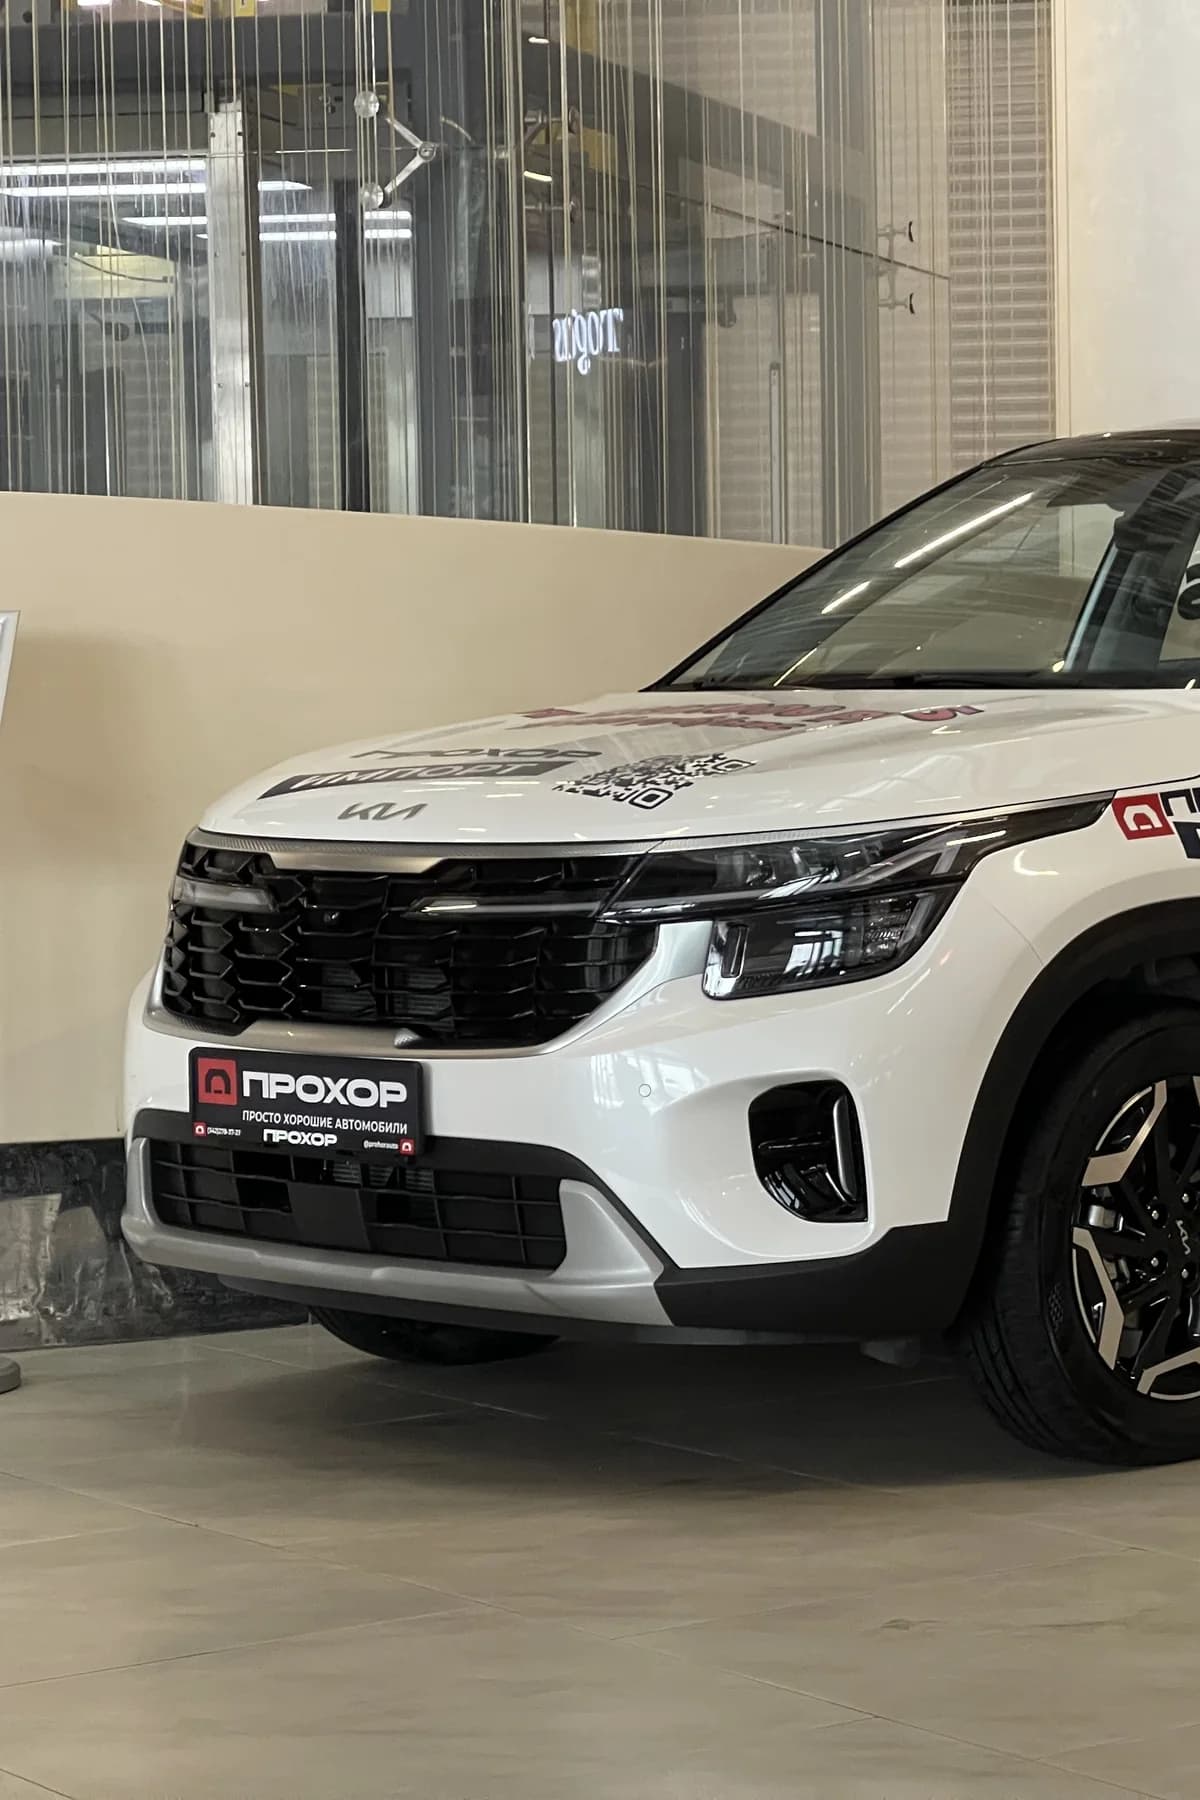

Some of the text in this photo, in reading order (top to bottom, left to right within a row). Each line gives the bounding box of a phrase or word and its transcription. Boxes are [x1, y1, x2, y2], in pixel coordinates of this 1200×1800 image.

[290, 763, 538, 789] ИМПОРТ
[242, 1070, 408, 1109] ПРОХОР
[242, 1110, 408, 1135] ПРОСТО ХОРОШИЕ АВТОМОБИЛИ
[263, 1128, 338, 1147] ПРОХОР
